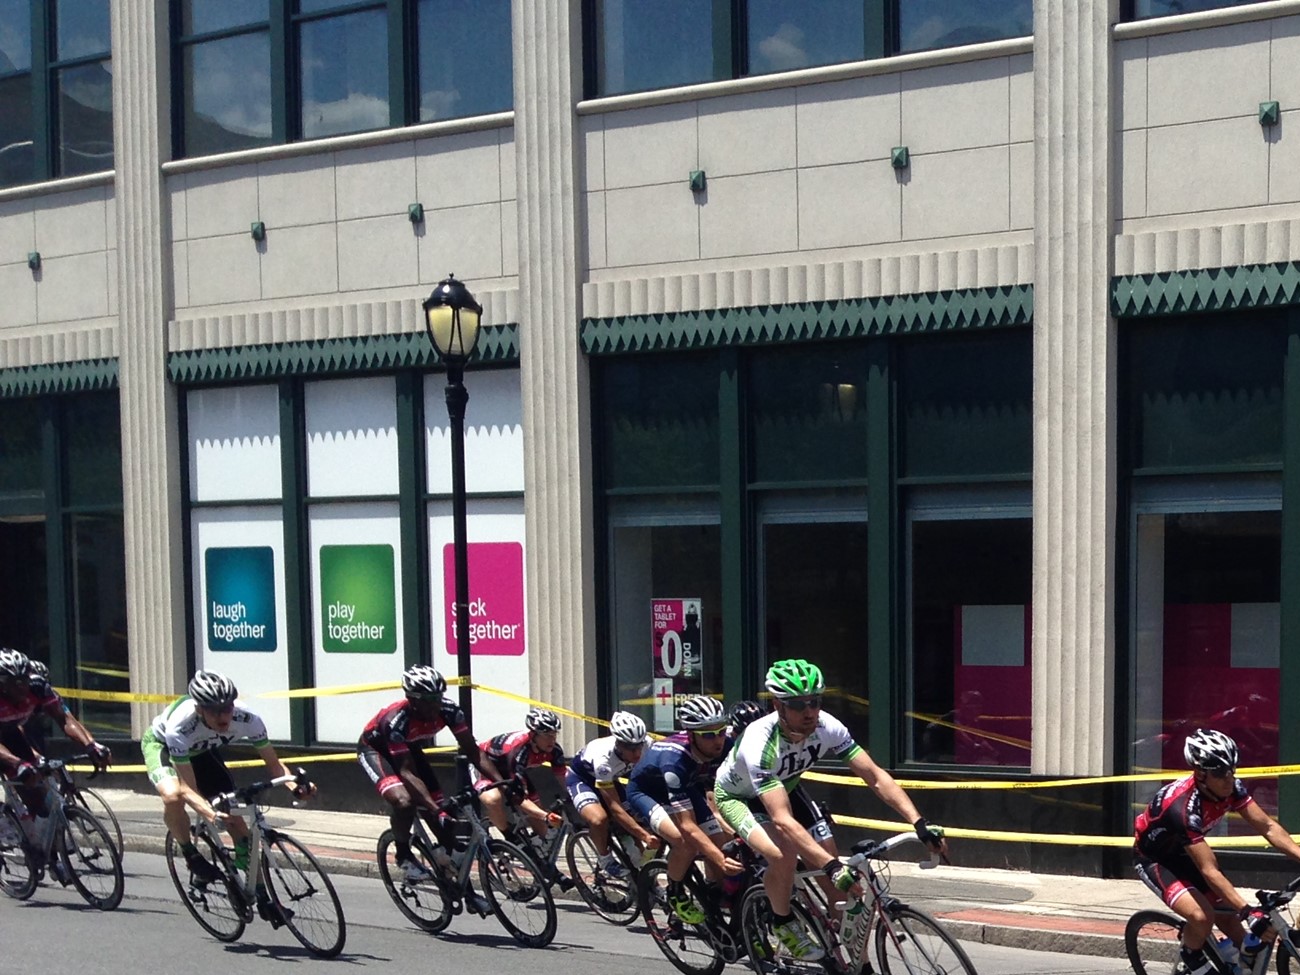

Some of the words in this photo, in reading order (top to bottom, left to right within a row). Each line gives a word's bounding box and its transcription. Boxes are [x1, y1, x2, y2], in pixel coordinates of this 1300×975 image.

[212, 601, 246, 622] laugh
[327, 601, 356, 622] play
[451, 597, 487, 617] sck
[653, 604, 666, 612] GET
[667, 604, 672, 612] A
[654, 613, 677, 621] TABLET
[212, 621, 266, 642] together
[327, 621, 385, 643] together
[451, 620, 518, 644] tgether
[654, 621, 667, 629] FOR
[683, 642, 692, 677] DOWN
